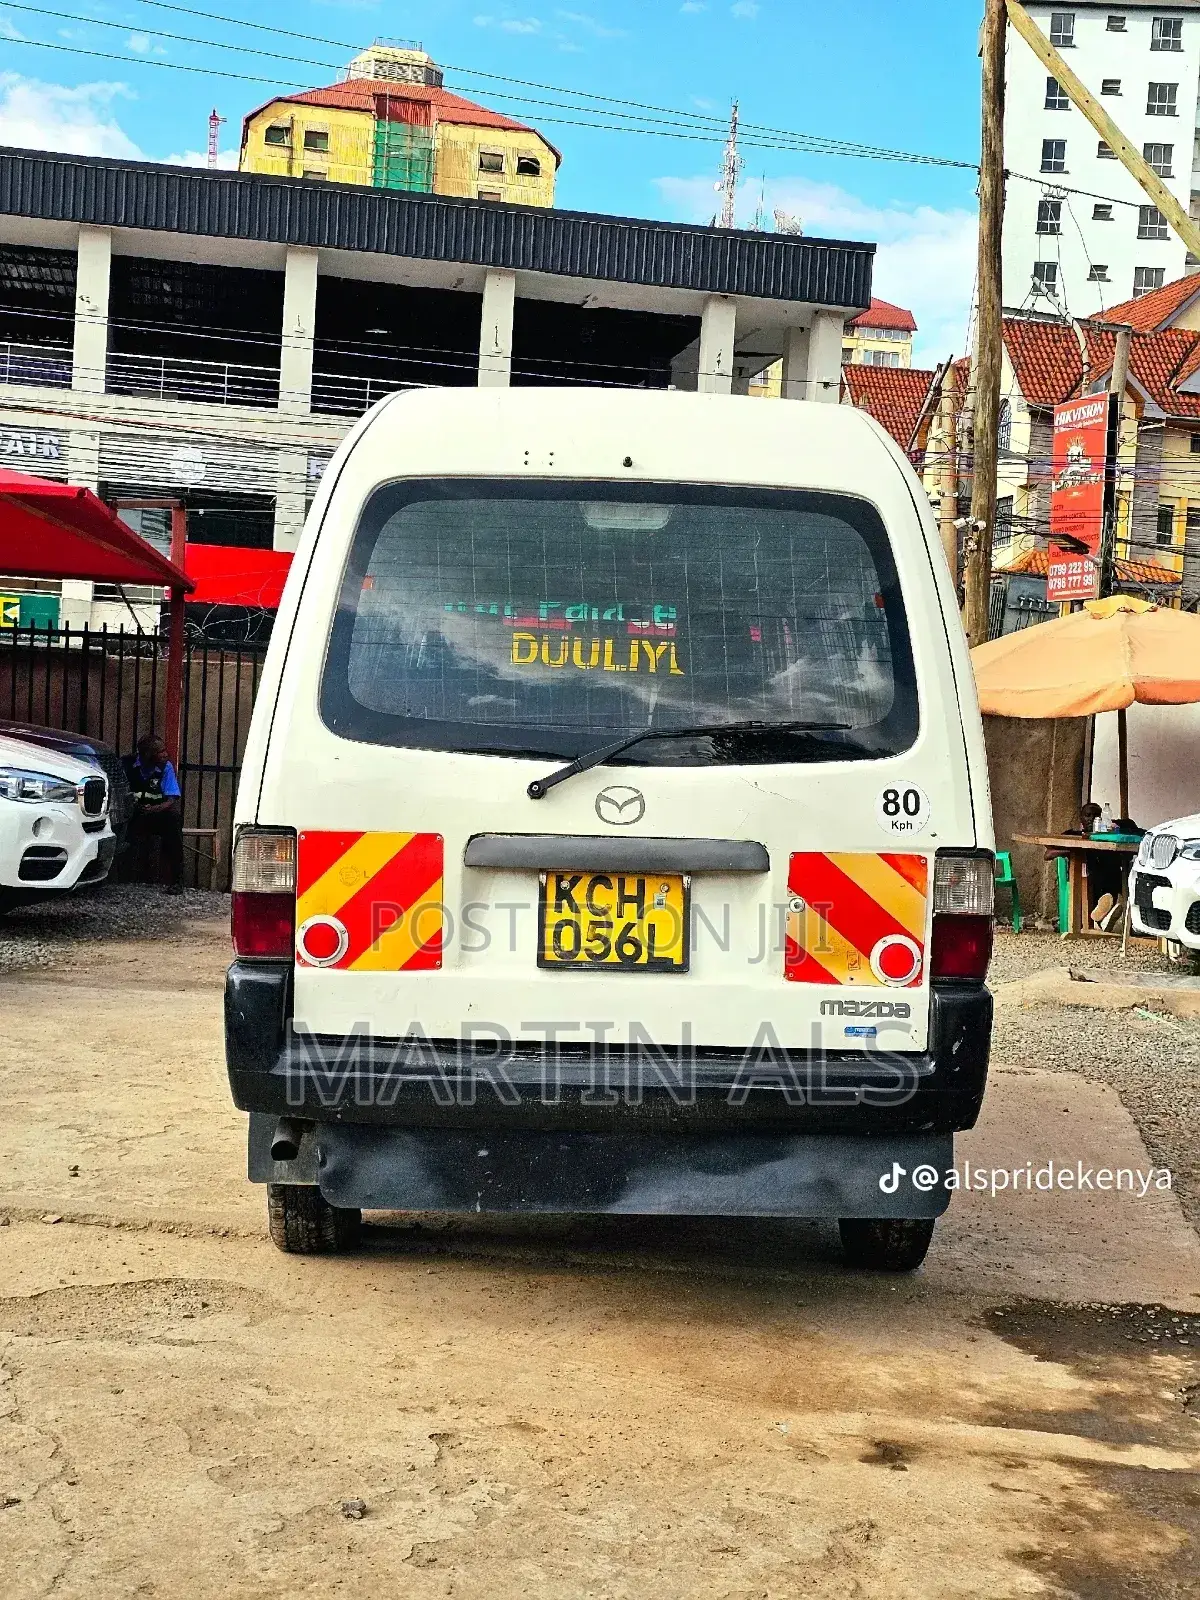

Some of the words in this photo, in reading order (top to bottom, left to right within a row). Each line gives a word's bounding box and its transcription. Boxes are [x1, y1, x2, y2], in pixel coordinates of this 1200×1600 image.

[1054, 402, 1104, 426] HIKVISION
[0, 431, 59, 457] AIR
[1067, 561, 1082, 575] 222
[1083, 560, 1095, 573] 99
[1067, 575, 1082, 588] 777
[1083, 574, 1095, 586] 99
[882, 789, 920, 816] 80
[891, 820, 913, 833] Kph
[554, 874, 646, 919] KCH
[552, 919, 674, 964] 056L
[820, 999, 911, 1019] mazda
